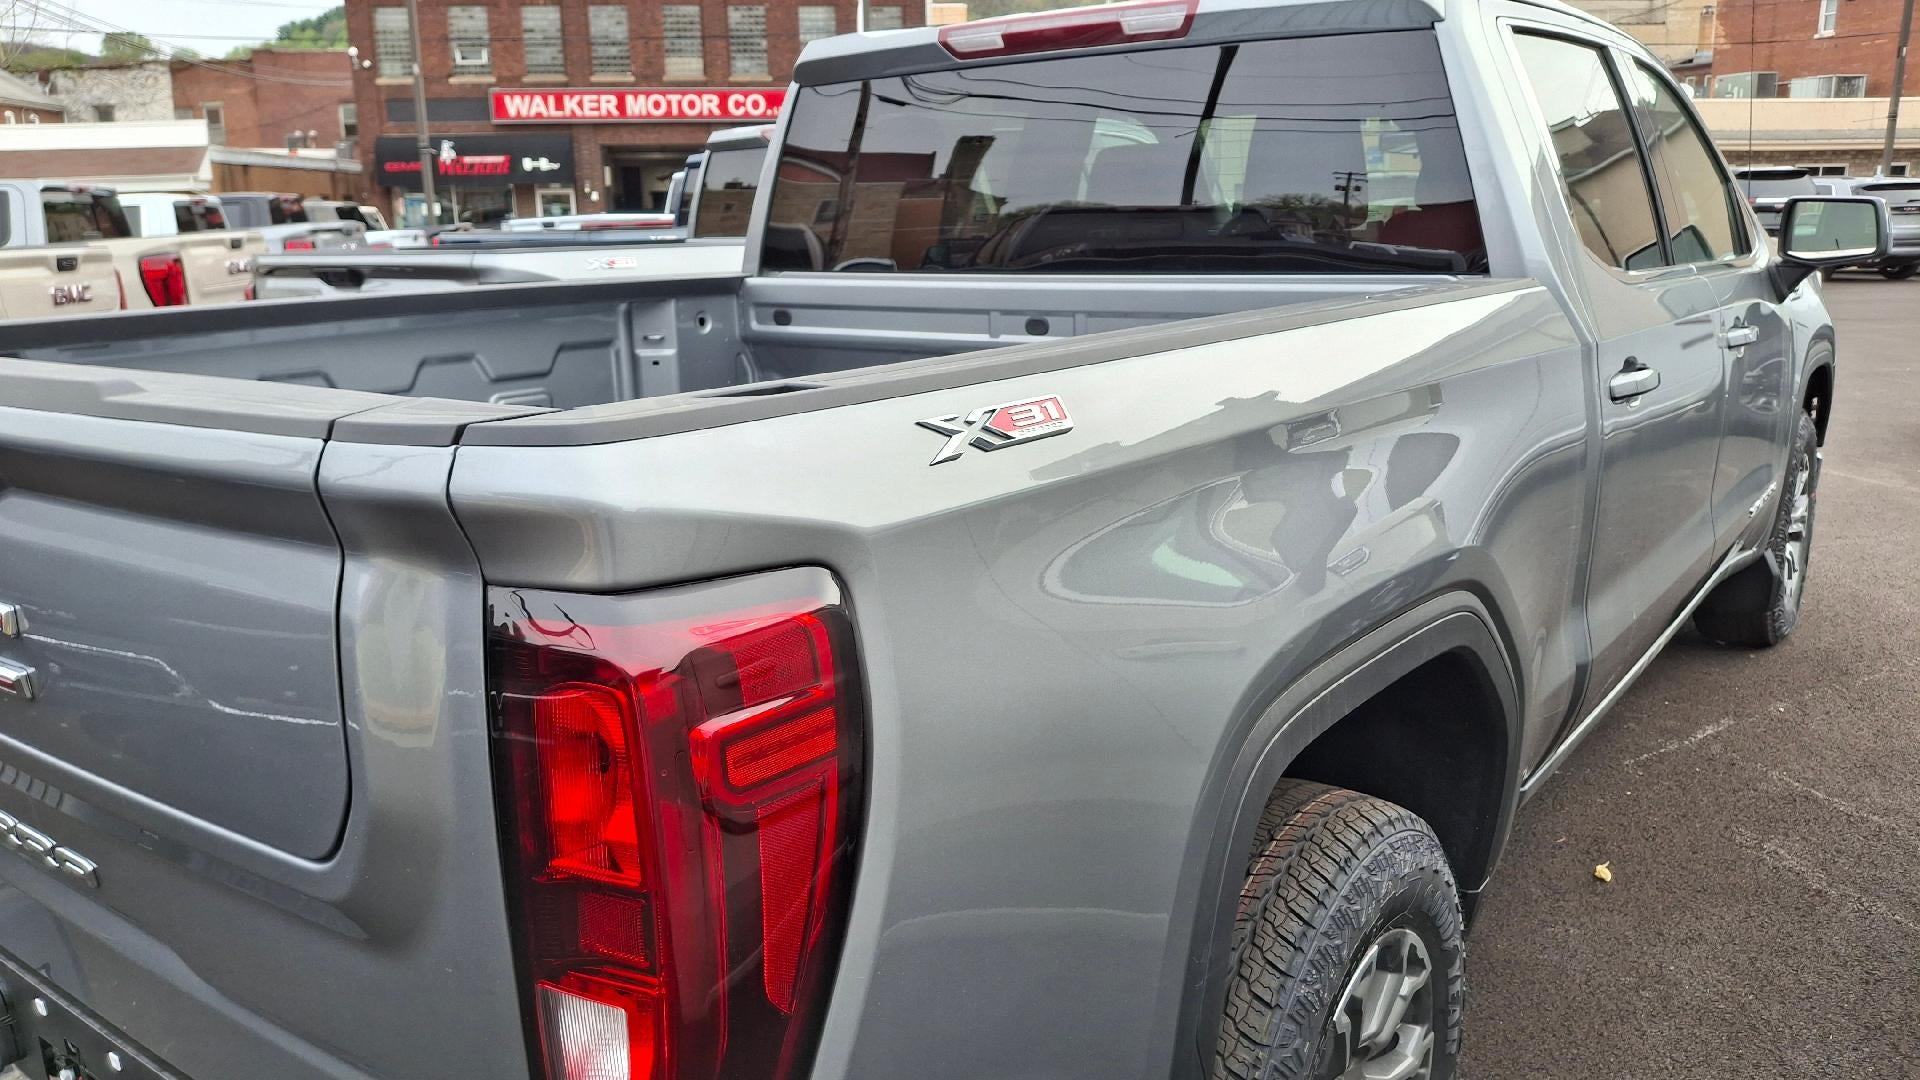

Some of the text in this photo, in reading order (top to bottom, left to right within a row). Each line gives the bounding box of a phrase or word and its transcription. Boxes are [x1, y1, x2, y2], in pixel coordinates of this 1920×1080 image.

[504, 94, 619, 117] WALKER
[625, 94, 721, 116] MOTOR
[727, 94, 773, 116] CO.
